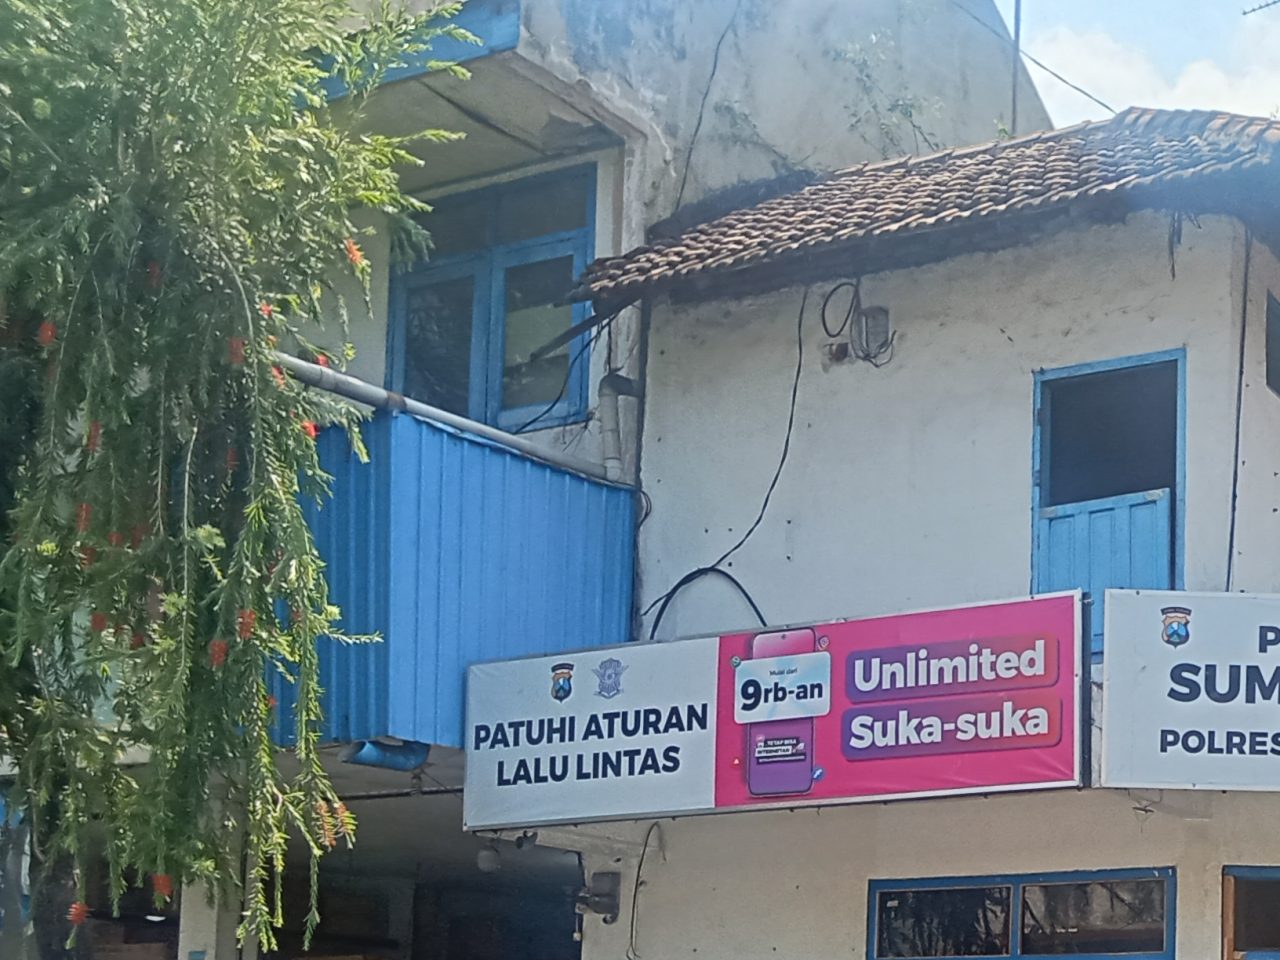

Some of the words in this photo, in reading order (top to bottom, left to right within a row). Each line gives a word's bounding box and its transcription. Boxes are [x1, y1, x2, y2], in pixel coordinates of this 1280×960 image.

[855, 640, 1045, 691] Unlimited
[741, 679, 823, 711] 9rb-an
[473, 715, 575, 750] PATUHI
[582, 703, 709, 741] ATURAN
[850, 701, 1047, 748] Suka-suka
[496, 755, 568, 786] LALU
[575, 746, 681, 781] LINTAS
